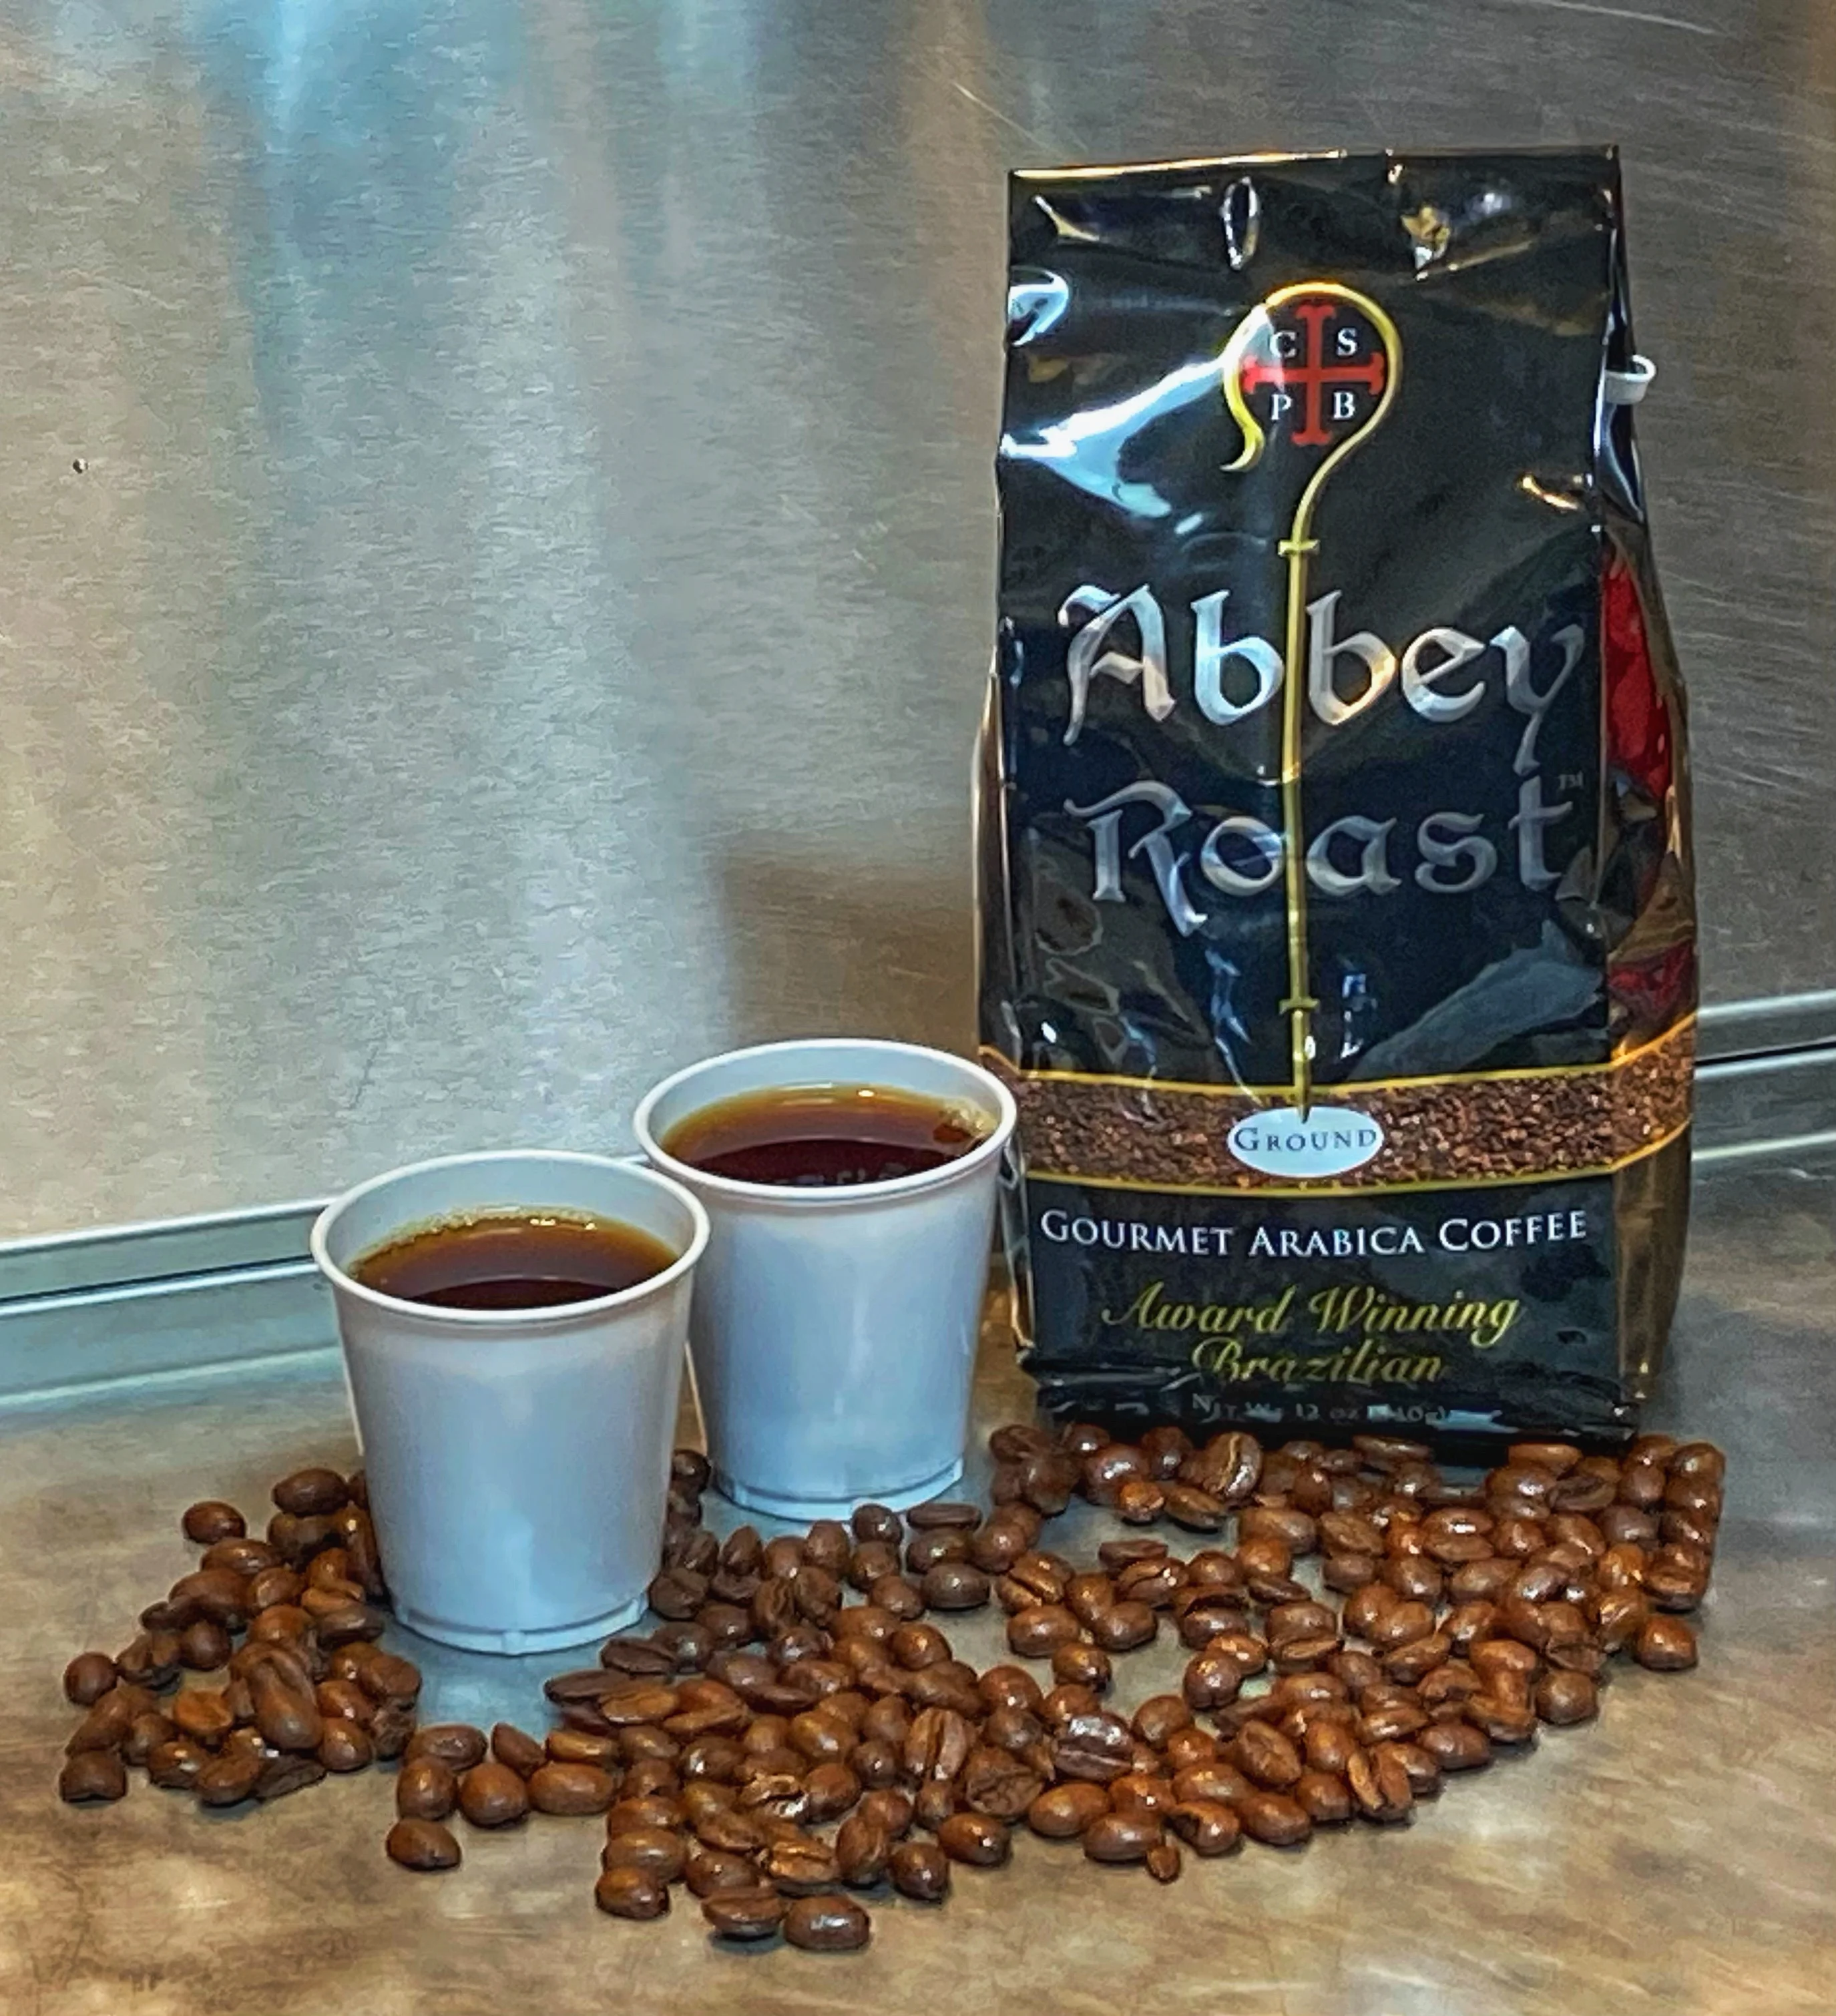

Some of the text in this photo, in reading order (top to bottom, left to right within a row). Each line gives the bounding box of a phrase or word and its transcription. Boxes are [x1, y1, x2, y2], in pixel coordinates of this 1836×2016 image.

[1269, 328, 1357, 358] C S
[1271, 391, 1356, 421] P B
[1058, 584, 1585, 775] Abbey
[1064, 775, 1574, 936] Roast
[1234, 1126, 1377, 1154] GROUND
[1041, 1209, 1587, 1258] GOURMET ARABICA COFFEE
[1101, 1281, 1525, 1348] Award Winning
[1192, 1336, 1445, 1385] Brazilian
